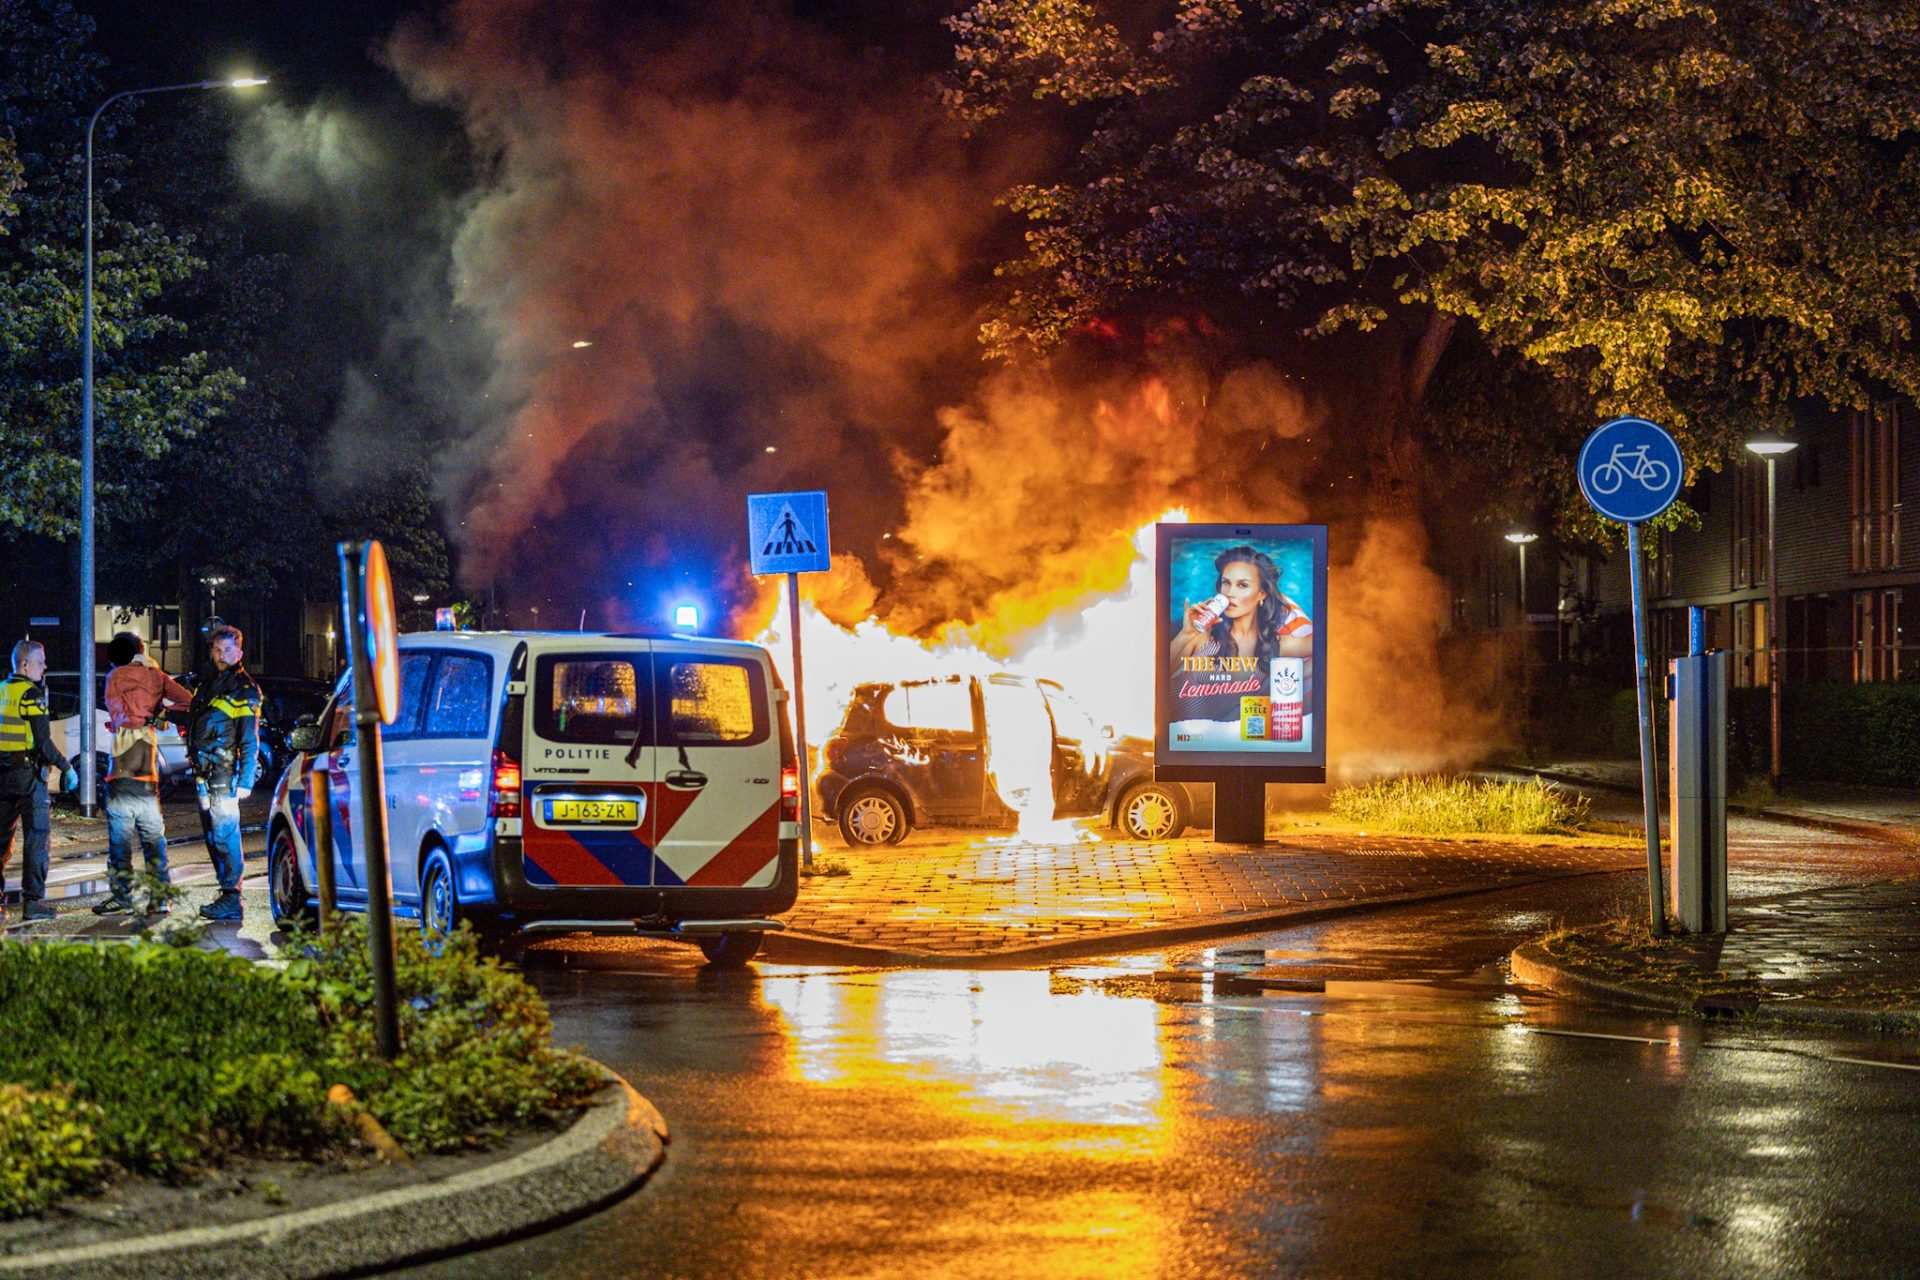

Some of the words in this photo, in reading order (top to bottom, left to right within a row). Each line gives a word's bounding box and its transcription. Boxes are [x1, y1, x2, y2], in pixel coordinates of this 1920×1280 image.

[1181, 656, 1216, 672] THE
[1219, 656, 1259, 672] NEW
[1179, 674, 1261, 699] Lemonade
[545, 749, 610, 759] POLITIE
[561, 804, 626, 818] J-163-ZR
